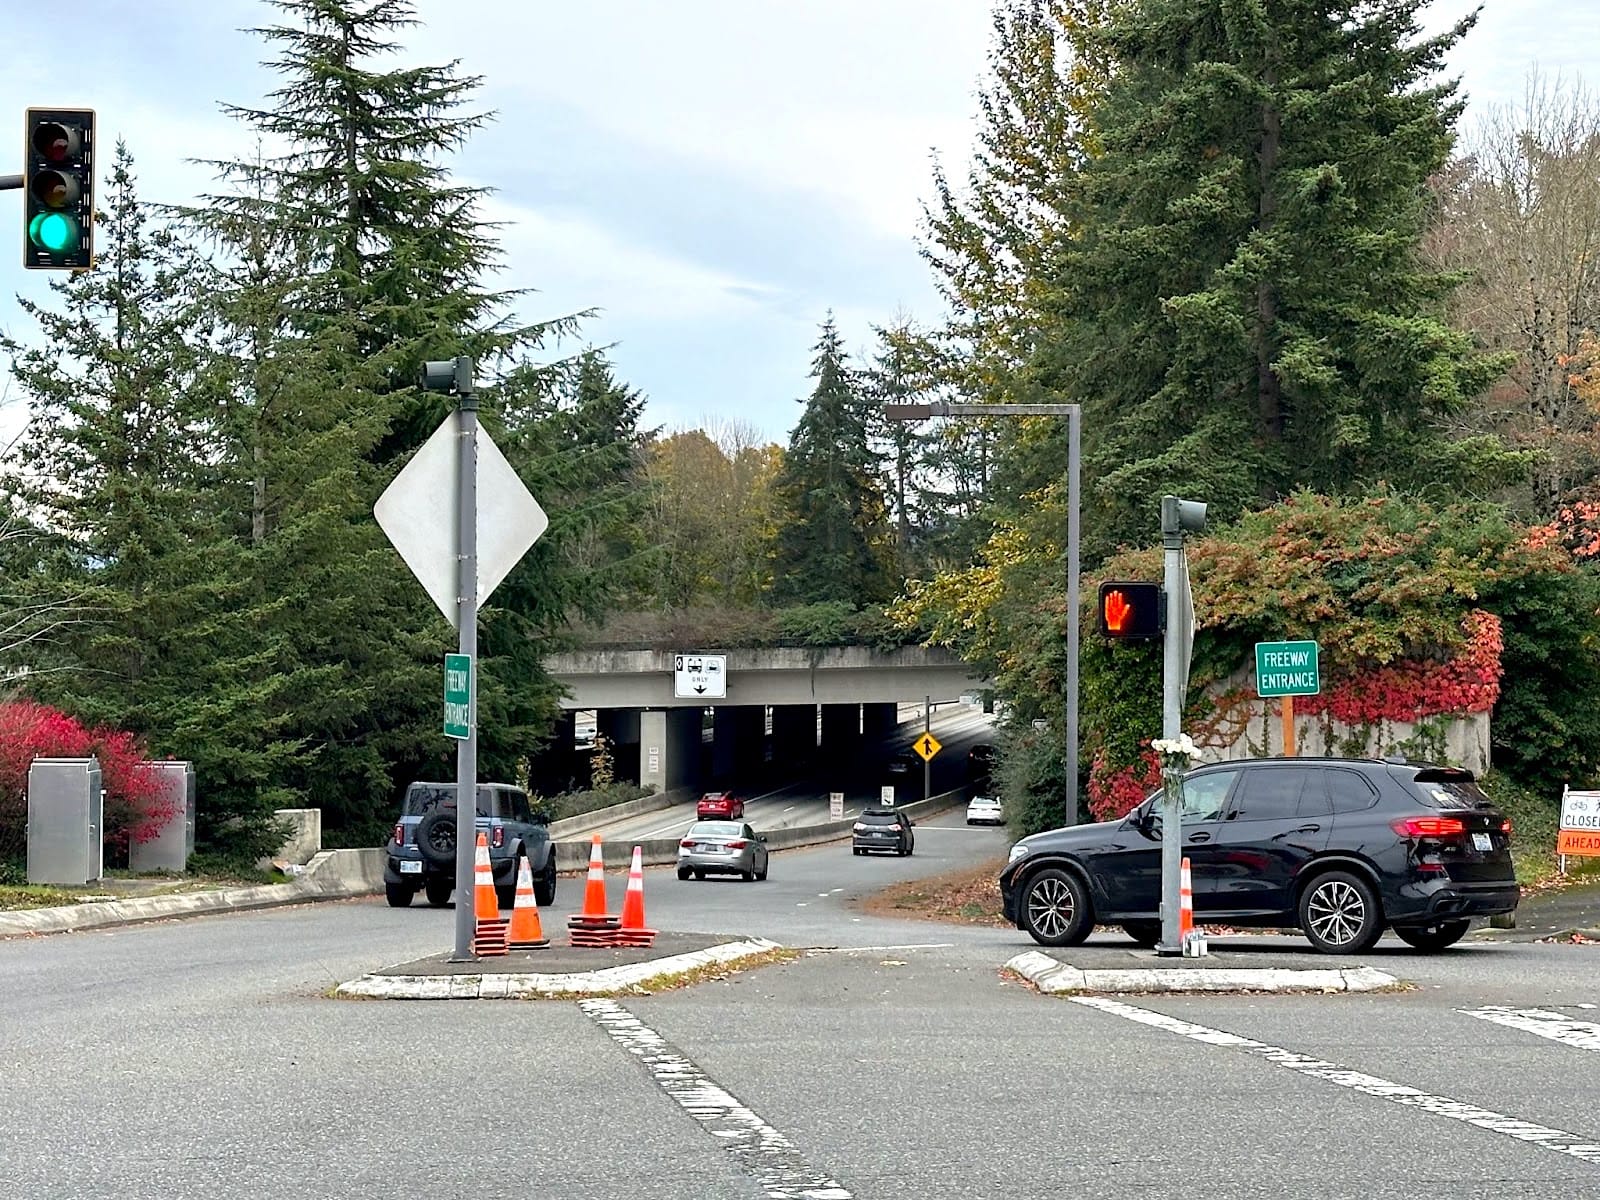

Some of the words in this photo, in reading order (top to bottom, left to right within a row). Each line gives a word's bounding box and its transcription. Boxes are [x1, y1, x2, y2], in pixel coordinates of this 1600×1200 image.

[1264, 651, 1309, 667] FREEWAY
[448, 669, 467, 693] FREEWAY
[1262, 672, 1315, 689] ENTRANCE
[446, 702, 468, 727] ENTRANCE
[1565, 814, 1600, 827] CLOSE
[1565, 837, 1600, 849] AHEAD
